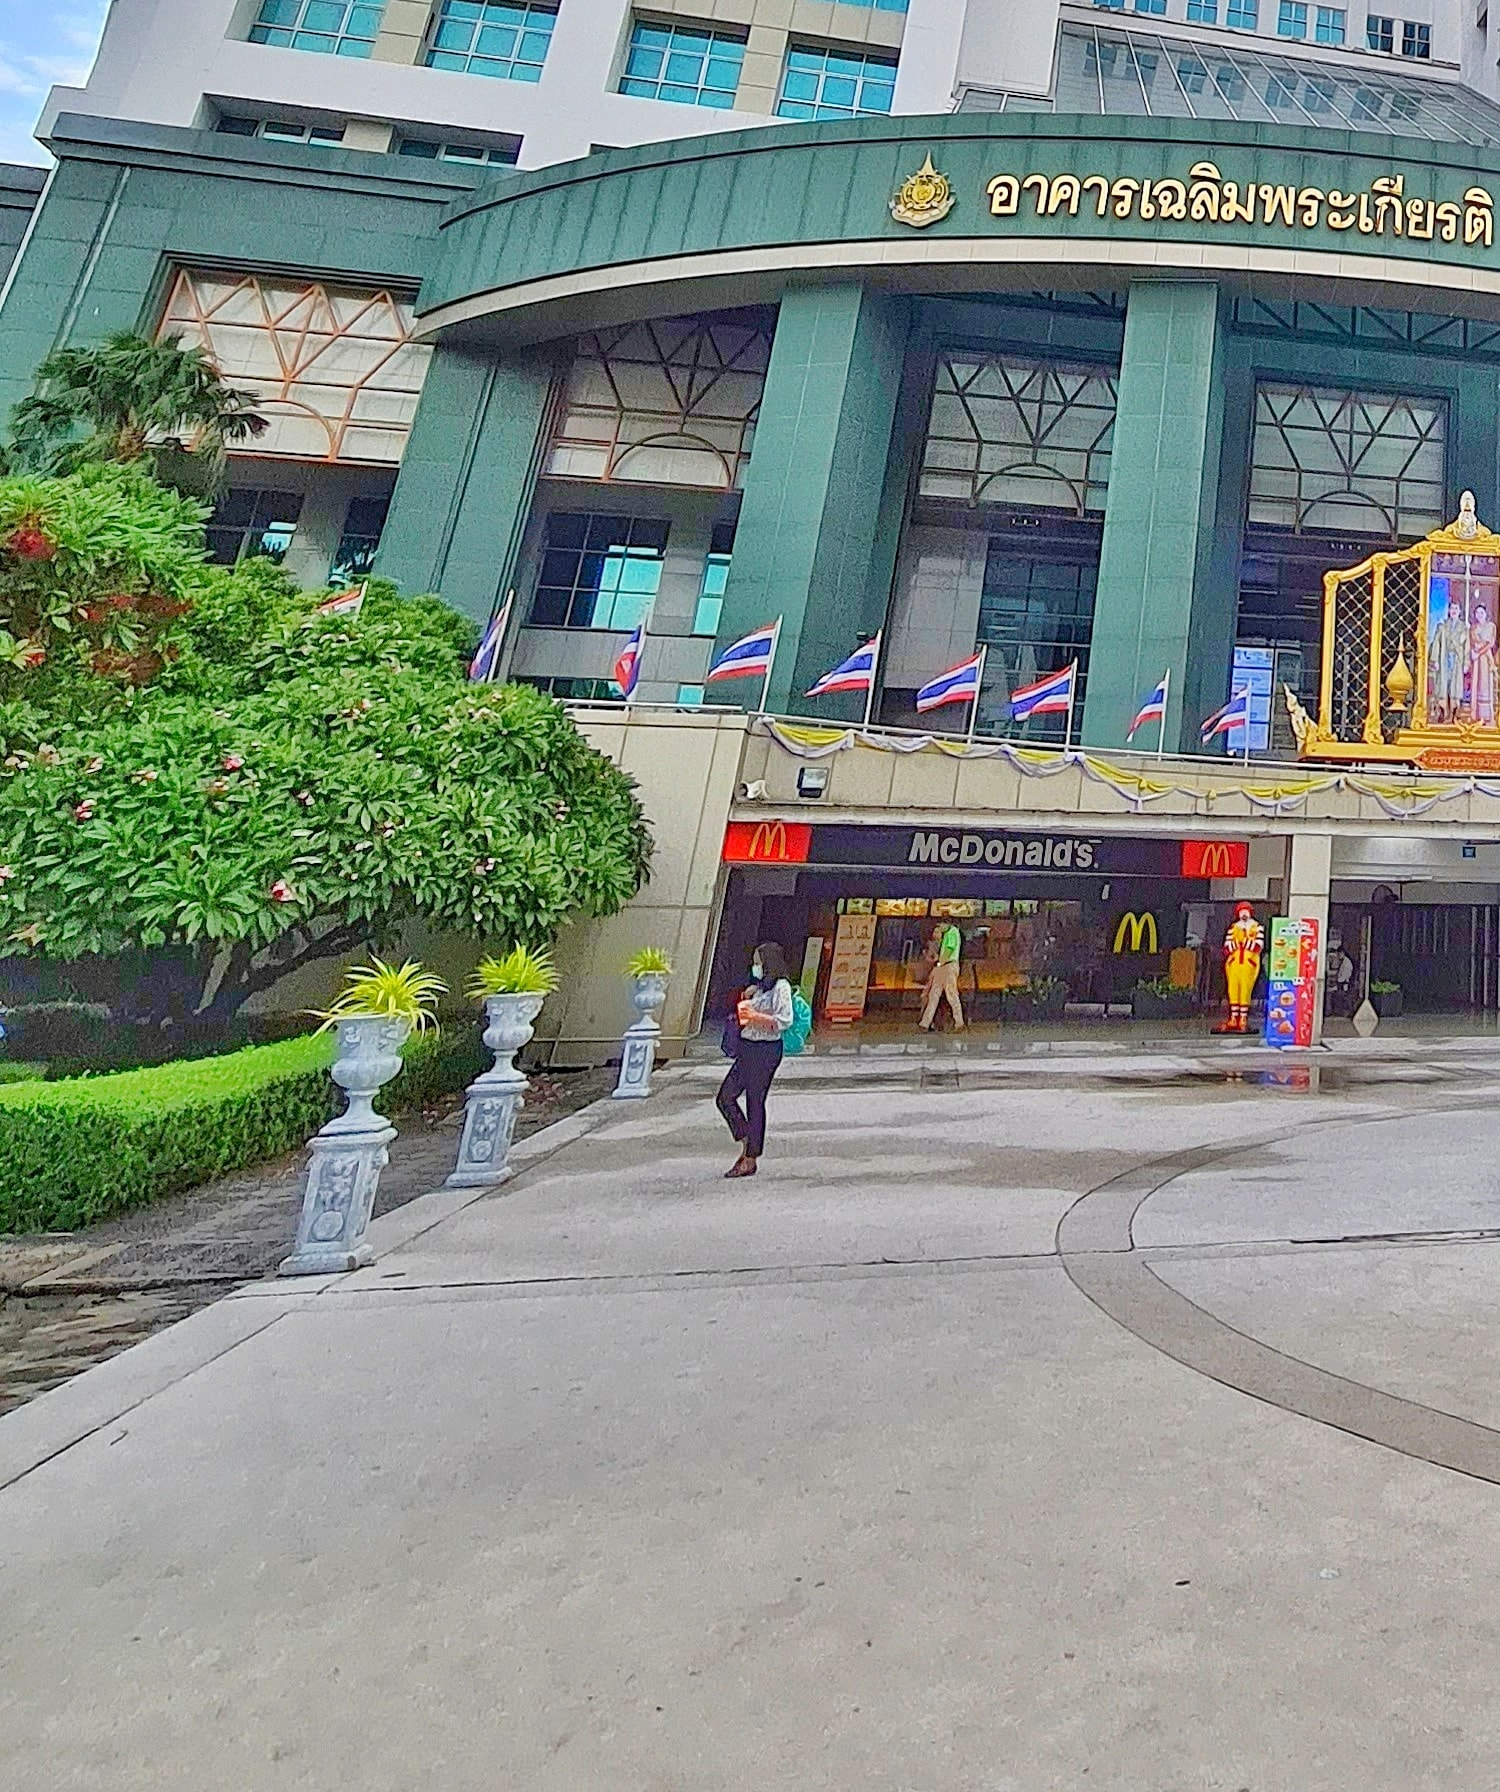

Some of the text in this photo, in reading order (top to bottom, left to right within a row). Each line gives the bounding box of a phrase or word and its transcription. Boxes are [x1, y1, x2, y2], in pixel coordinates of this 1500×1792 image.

[986, 160, 1494, 247] อาคารเฉลิมพระเกียรติ
[908, 832, 1094, 869] McDonald's
